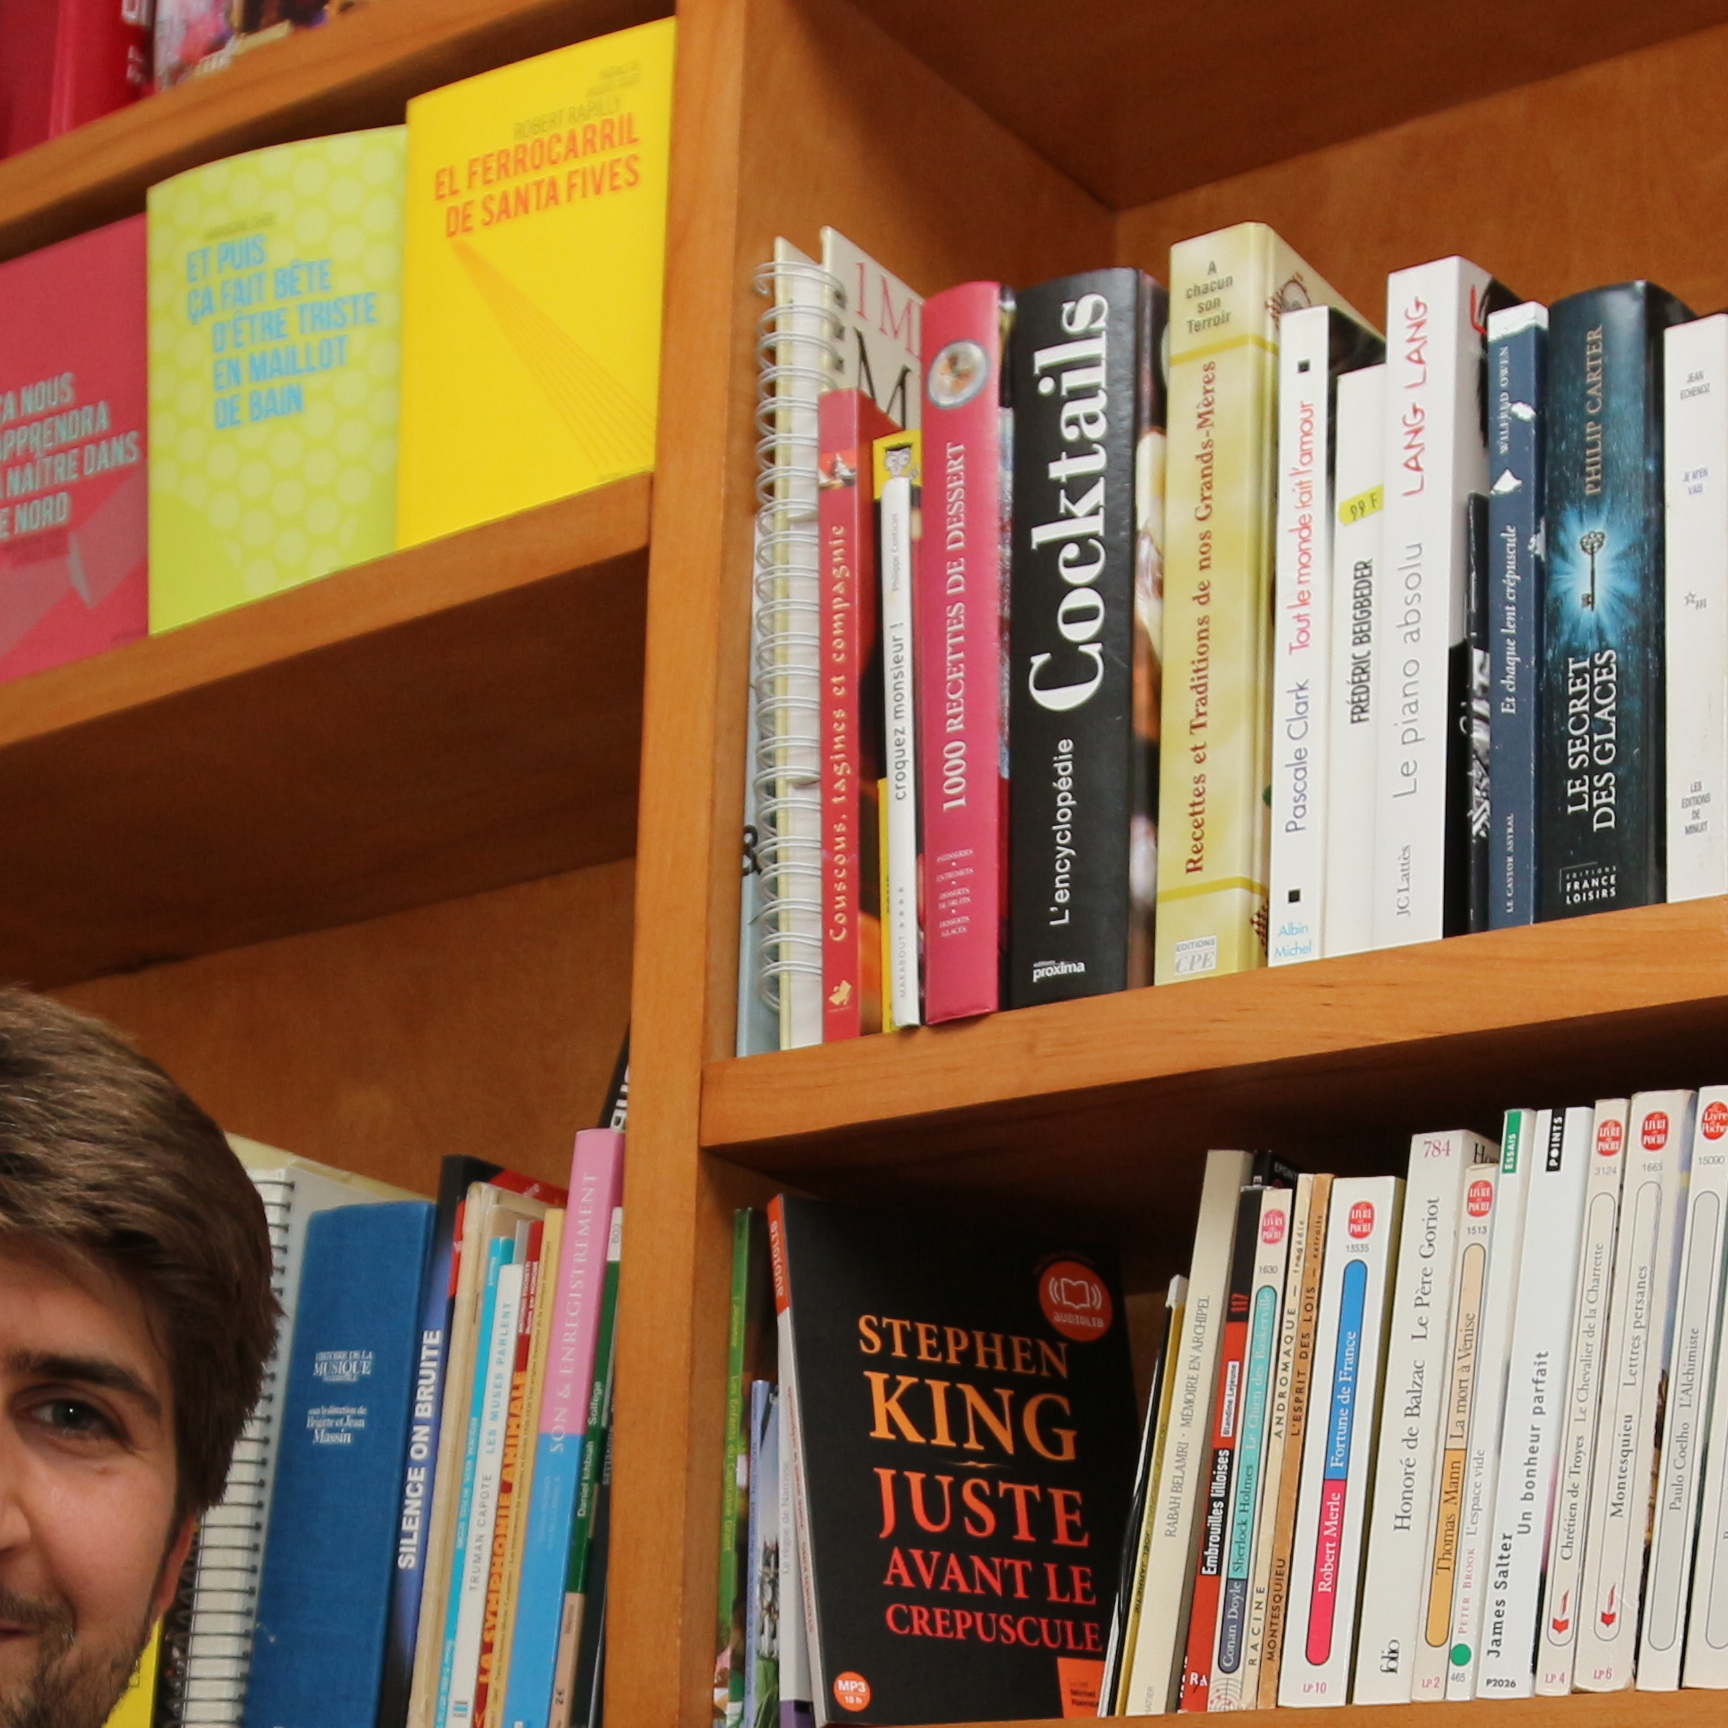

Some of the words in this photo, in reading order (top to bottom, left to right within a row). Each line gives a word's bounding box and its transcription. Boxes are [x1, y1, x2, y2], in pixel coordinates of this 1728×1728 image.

[434, 165, 460, 201] EL
[468, 112, 640, 190] FERROCARRIL
[446, 199, 474, 238] DE
[482, 175, 560, 227] SANTA
[567, 154, 640, 203] FIVES
[187, 249, 210, 282] ET
[218, 233, 266, 273] PUIS
[187, 290, 214, 325] ÇA
[221, 271, 266, 314] FAIT
[274, 258, 333, 298] BÊTE
[212, 308, 287, 353] D'ÊTRE
[298, 291, 378, 334] TRISTE
[1405, 296, 1429, 389] LANG
[21, 371, 75, 416] NOUS
[213, 359, 243, 390] EN
[249, 334, 348, 383] MAILLOT
[1586, 324, 1604, 416] CARTER
[215, 397, 243, 429] DE
[250, 384, 303, 421] BAIN
[1195, 360, 1216, 521] Grands-Mères
[1291, 400, 1315, 477] l'amour
[6, 449, 78, 497] NAÎTRE
[83, 431, 139, 476] DANS
[1402, 402, 1426, 497] LANG
[1586, 420, 1603, 496] PHILIP
[14, 492, 69, 535] NORD
[945, 442, 967, 551] DESSERT
[1029, 292, 1110, 711] Cocktails
[1293, 478, 1314, 510] fait
[946, 563, 966, 595] DE
[1198, 530, 1212, 572] nos
[1288, 512, 1314, 582] monde
[1192, 580, 1211, 605] de
[1288, 591, 1312, 611] le
[1352, 558, 1373, 645] BEIGBEDER
[1396, 541, 1423, 644] absolu
[945, 604, 967, 734] RECETTES
[1288, 612, 1311, 655] Tout
[1187, 613, 1211, 735] Traditions
[1350, 649, 1371, 724] FRÉDÉRIC
[1394, 658, 1425, 746] piano
[1593, 649, 1617, 766] GLACES
[1286, 679, 1310, 741] Clark
[1568, 658, 1591, 770] SECRET
[943, 740, 967, 812] 1000
[1192, 741, 1207, 765] et
[1393, 760, 1418, 798] Le
[1185, 773, 1207, 875] Recettes
[1284, 746, 1308, 834] Pascale
[1567, 775, 1589, 815] LE
[1593, 770, 1615, 832] DES
[1049, 737, 1077, 926] L'encyclopédie
[1418, 1197, 1440, 1260] Goriot
[1414, 1268, 1433, 1319] Père
[314, 1358, 371, 1377] MUSIQUE
[857, 1313, 1069, 1379] STEPHEN
[1411, 1322, 1427, 1342] Le
[414, 1328, 443, 1418] BRUITE
[1275, 1307, 1296, 1438] ANDROMAQUE
[1405, 1359, 1426, 1420] Balzac
[410, 1424, 431, 1463] ON
[862, 1370, 1078, 1461] KING
[1401, 1423, 1419, 1449] de
[1394, 1457, 1417, 1533] Honoré
[1610, 1413, 1634, 1519] Montesquieu
[398, 1467, 426, 1570] SILENCE
[469, 1534, 485, 1591] TRUMAN
[477, 1474, 492, 1528] CAPOTE
[872, 1467, 1090, 1548] JUSTE
[1201, 1499, 1225, 1576] Embrouilles
[1213, 1449, 1230, 1499] lilloises
[883, 1546, 1032, 1598] AVANT
[1044, 1560, 1097, 1608] LE
[1494, 1533, 1514, 1591] Salter
[885, 1602, 1103, 1652] CREPUSCULE
[1267, 1558, 1287, 1661] MONTESQUIEU
[1487, 1598, 1506, 1658] James
